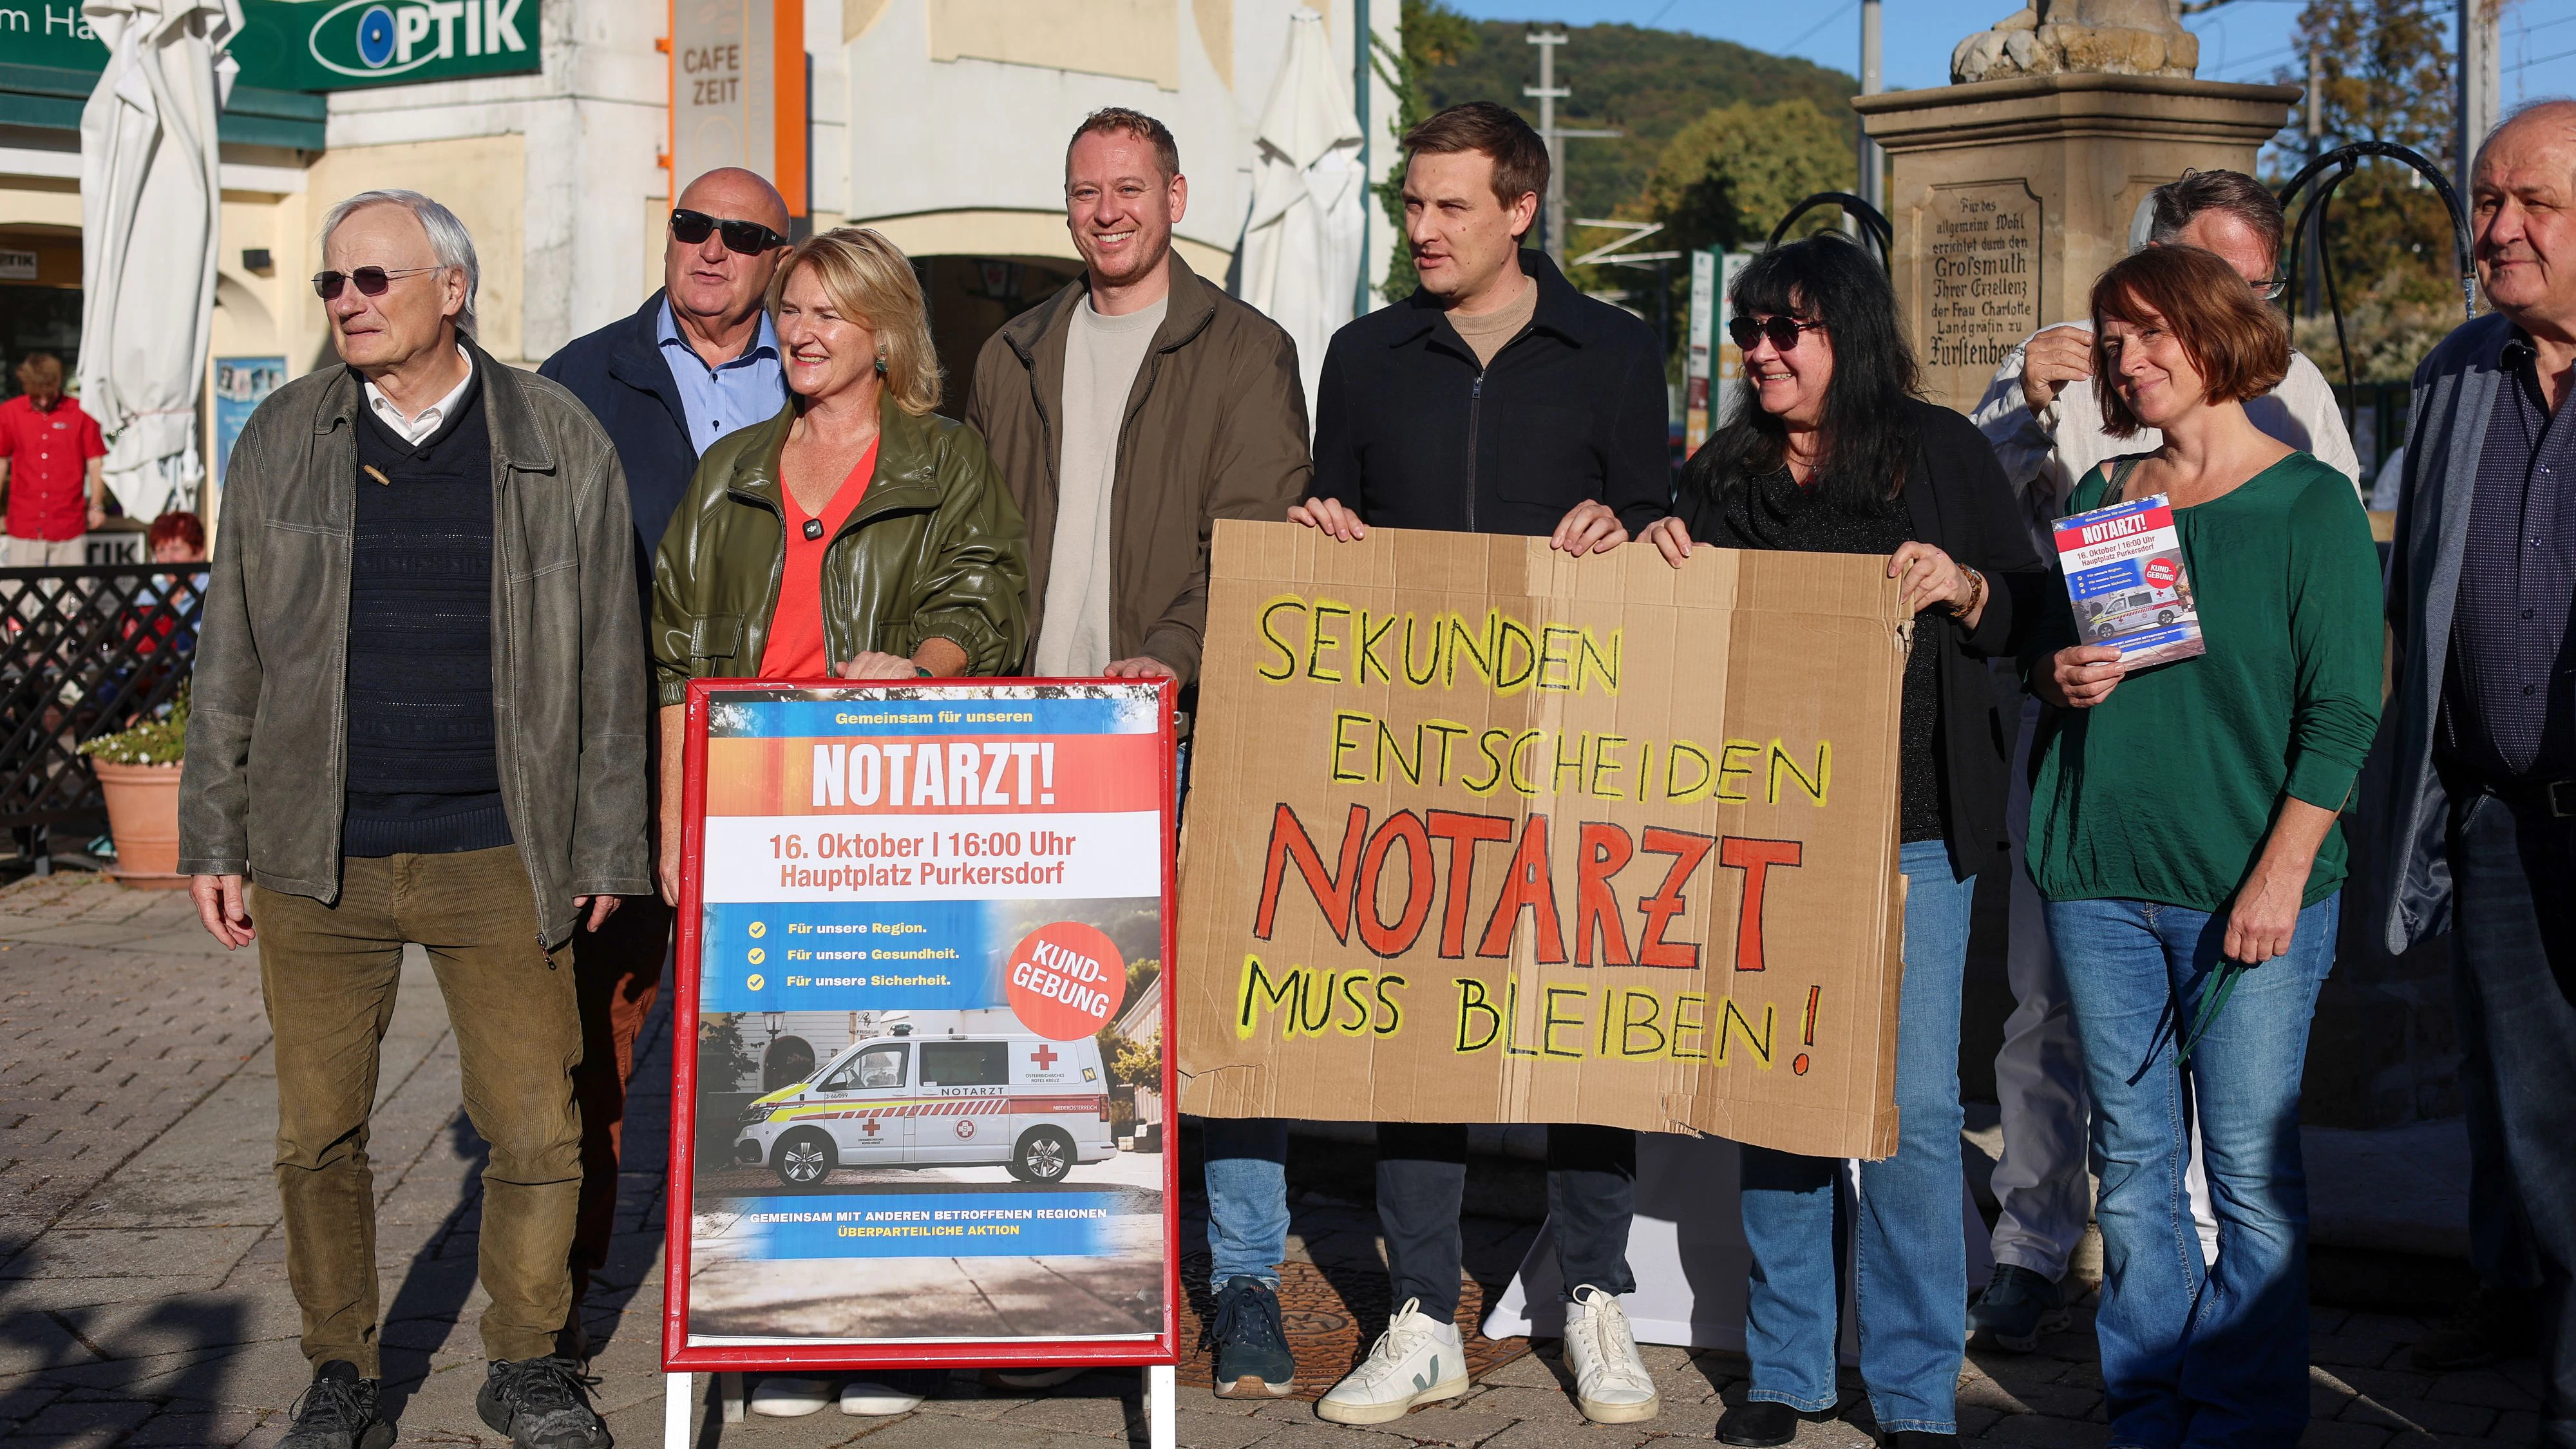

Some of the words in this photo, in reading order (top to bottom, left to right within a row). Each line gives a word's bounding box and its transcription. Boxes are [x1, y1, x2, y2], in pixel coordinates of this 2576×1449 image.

[356, 0, 527, 69] OPTIK
[683, 44, 741, 75] CAFE
[692, 77, 741, 106] ZEIT
[1937, 218, 1989, 238] allgemeine
[1996, 213, 2025, 230] Wohl
[1933, 237, 1977, 254] errichtet
[2009, 235, 2027, 249] den
[1933, 278, 1967, 300] Ihrer
[1931, 303, 1949, 317] der
[1953, 301, 1975, 317] Frau
[1982, 301, 2031, 316] Charlotte
[2009, 323, 2022, 332] zu
[2081, 513, 2147, 545] NOTARZT!
[2081, 553, 2116, 566] Hauptplatz
[2116, 544, 2154, 558] Purkersdorf
[2089, 545, 2116, 556] Oktober
[2122, 538, 2141, 549] 16:00
[2143, 536, 2155, 544] Uhr
[2146, 571, 2174, 581] GEBUNG
[2150, 564, 2172, 573] KUND-
[1255, 594, 1623, 696] SEKUNDEN
[835, 712, 933, 724] Gemeinsam
[938, 710, 961, 723] für
[966, 712, 1033, 723] unseren
[1331, 710, 1831, 806] ENTSCHEIDEN
[812, 742, 1054, 806] NOTARZT!
[770, 834, 808, 859] 16.
[818, 832, 924, 858] Oktober
[949, 831, 1021, 857] 16:00
[1030, 831, 1076, 856] Uhr
[781, 864, 912, 892] Hauptplatz
[920, 861, 1064, 886] Purkersdorf
[1254, 801, 1803, 972] NOTARZT
[788, 923, 813, 934] Für
[817, 924, 867, 934] unsere
[872, 922, 927, 936] Region.
[788, 949, 812, 960] Für
[816, 951, 867, 960] unsere
[871, 948, 960, 960] Gesundheit.
[1031, 940, 1108, 983] KUND-
[786, 976, 811, 987] Für
[815, 976, 866, 986] unsere
[871, 974, 951, 986] Sicherheit.
[1012, 962, 1110, 1019] GEBUNG
[1236, 953, 1410, 1040] MUSS
[941, 1087, 1004, 1096] NOTARZT
[750, 1212, 832, 1223] GEMEINSAM
[837, 1211, 862, 1222] MIT
[865, 1211, 930, 1221] ANDEREN
[934, 1209, 1032, 1220] BETROFFENEN
[1036, 1209, 1106, 1219] REGIONEN
[838, 1225, 963, 1237] ÜBERPARTEILICHE
[967, 1225, 1019, 1235] AKTION
